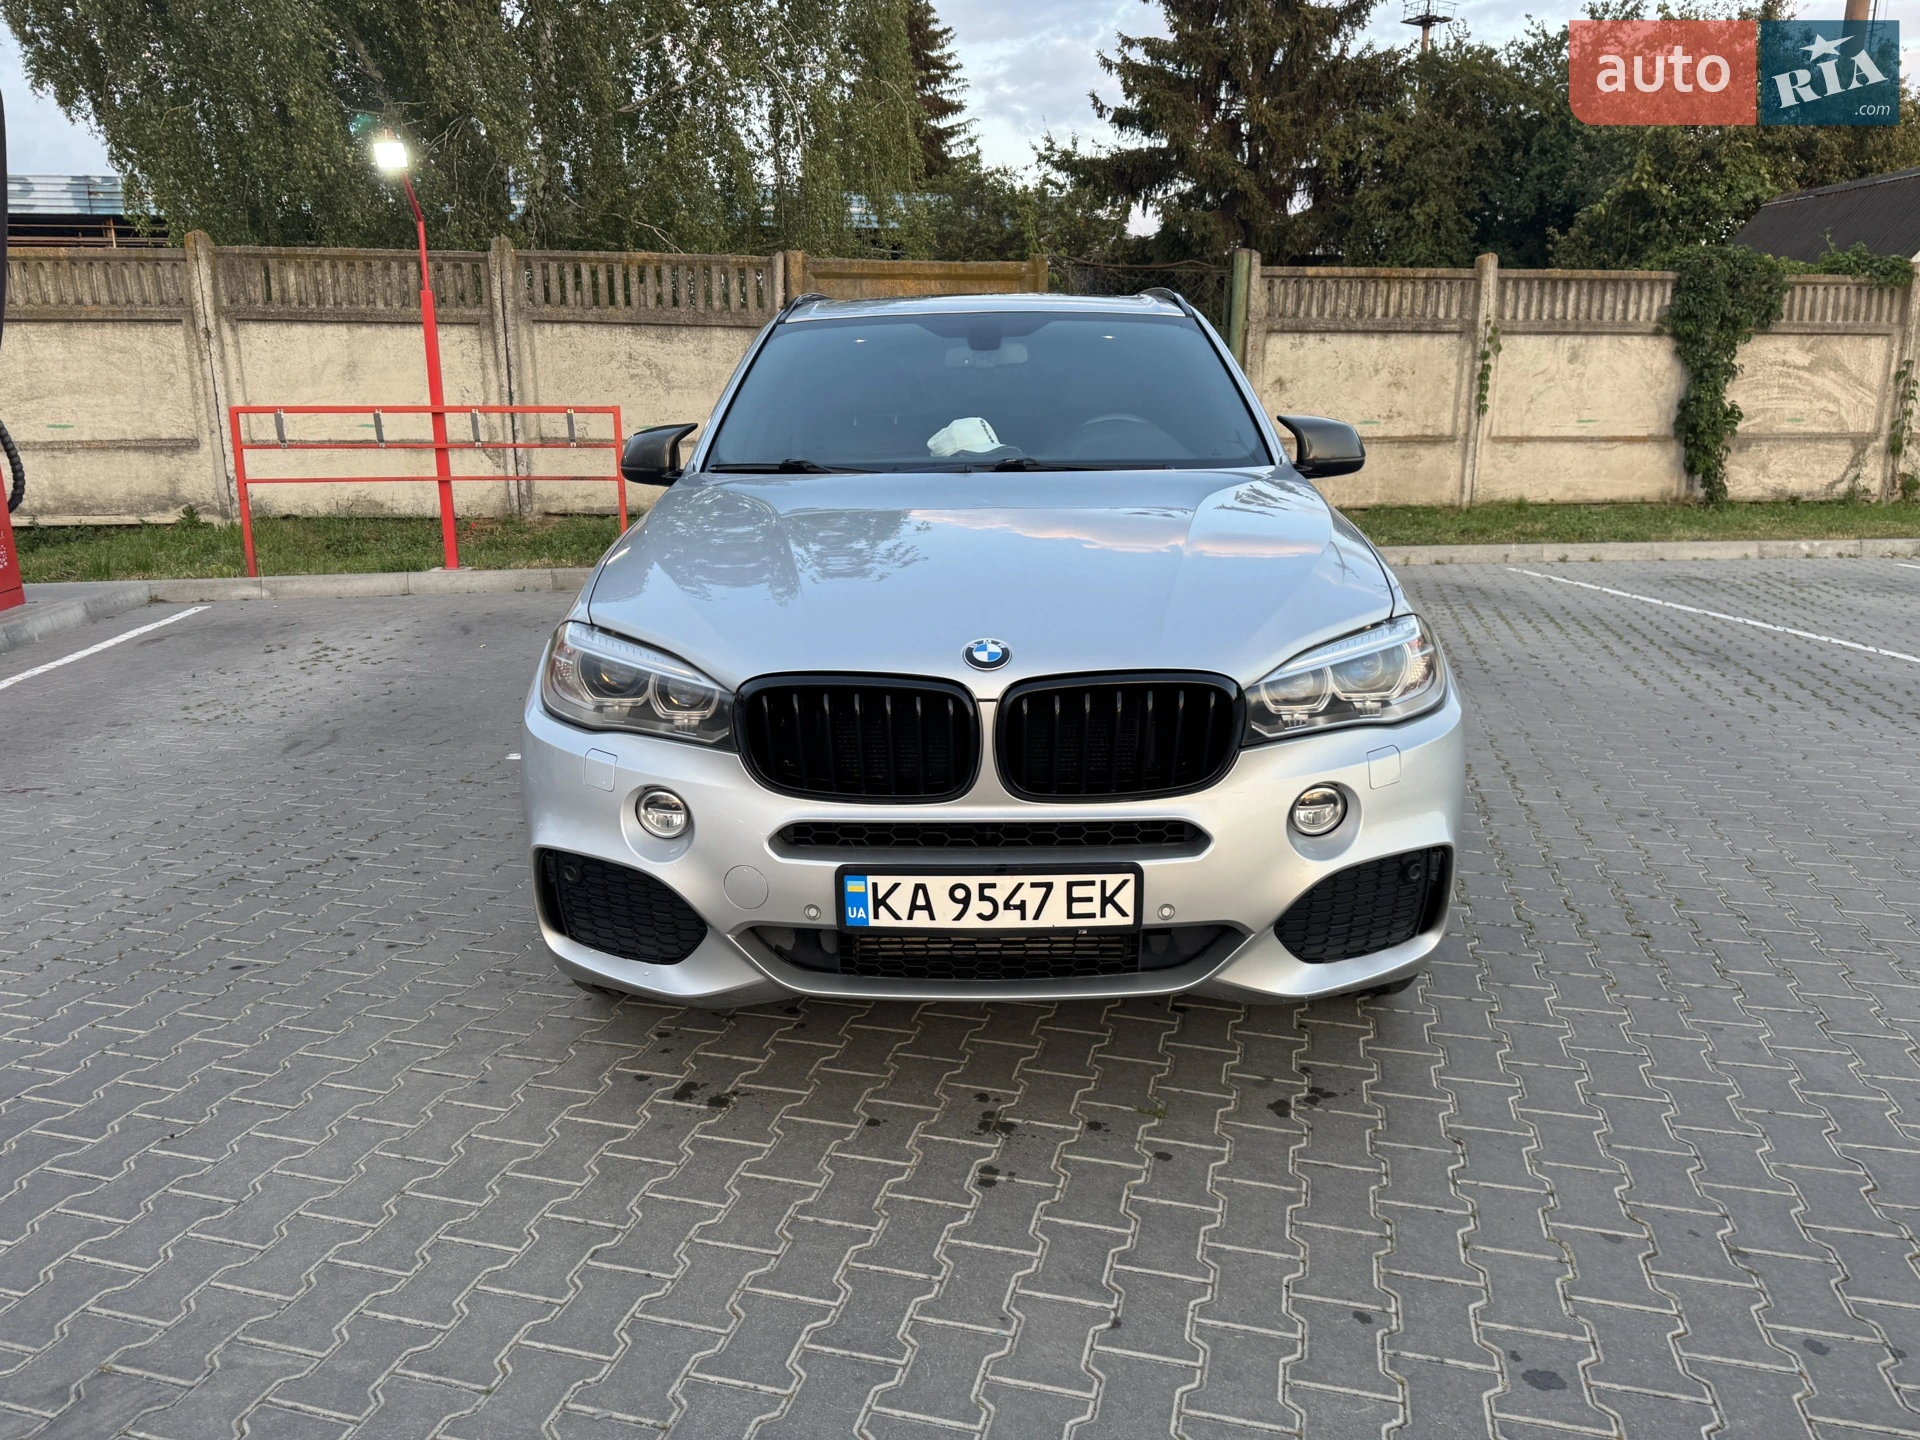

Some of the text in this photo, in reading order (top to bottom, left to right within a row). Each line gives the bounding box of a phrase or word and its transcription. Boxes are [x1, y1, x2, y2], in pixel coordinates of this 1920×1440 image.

[847, 906, 867, 919] UA
[871, 878, 1131, 922] KA 9547 EK
